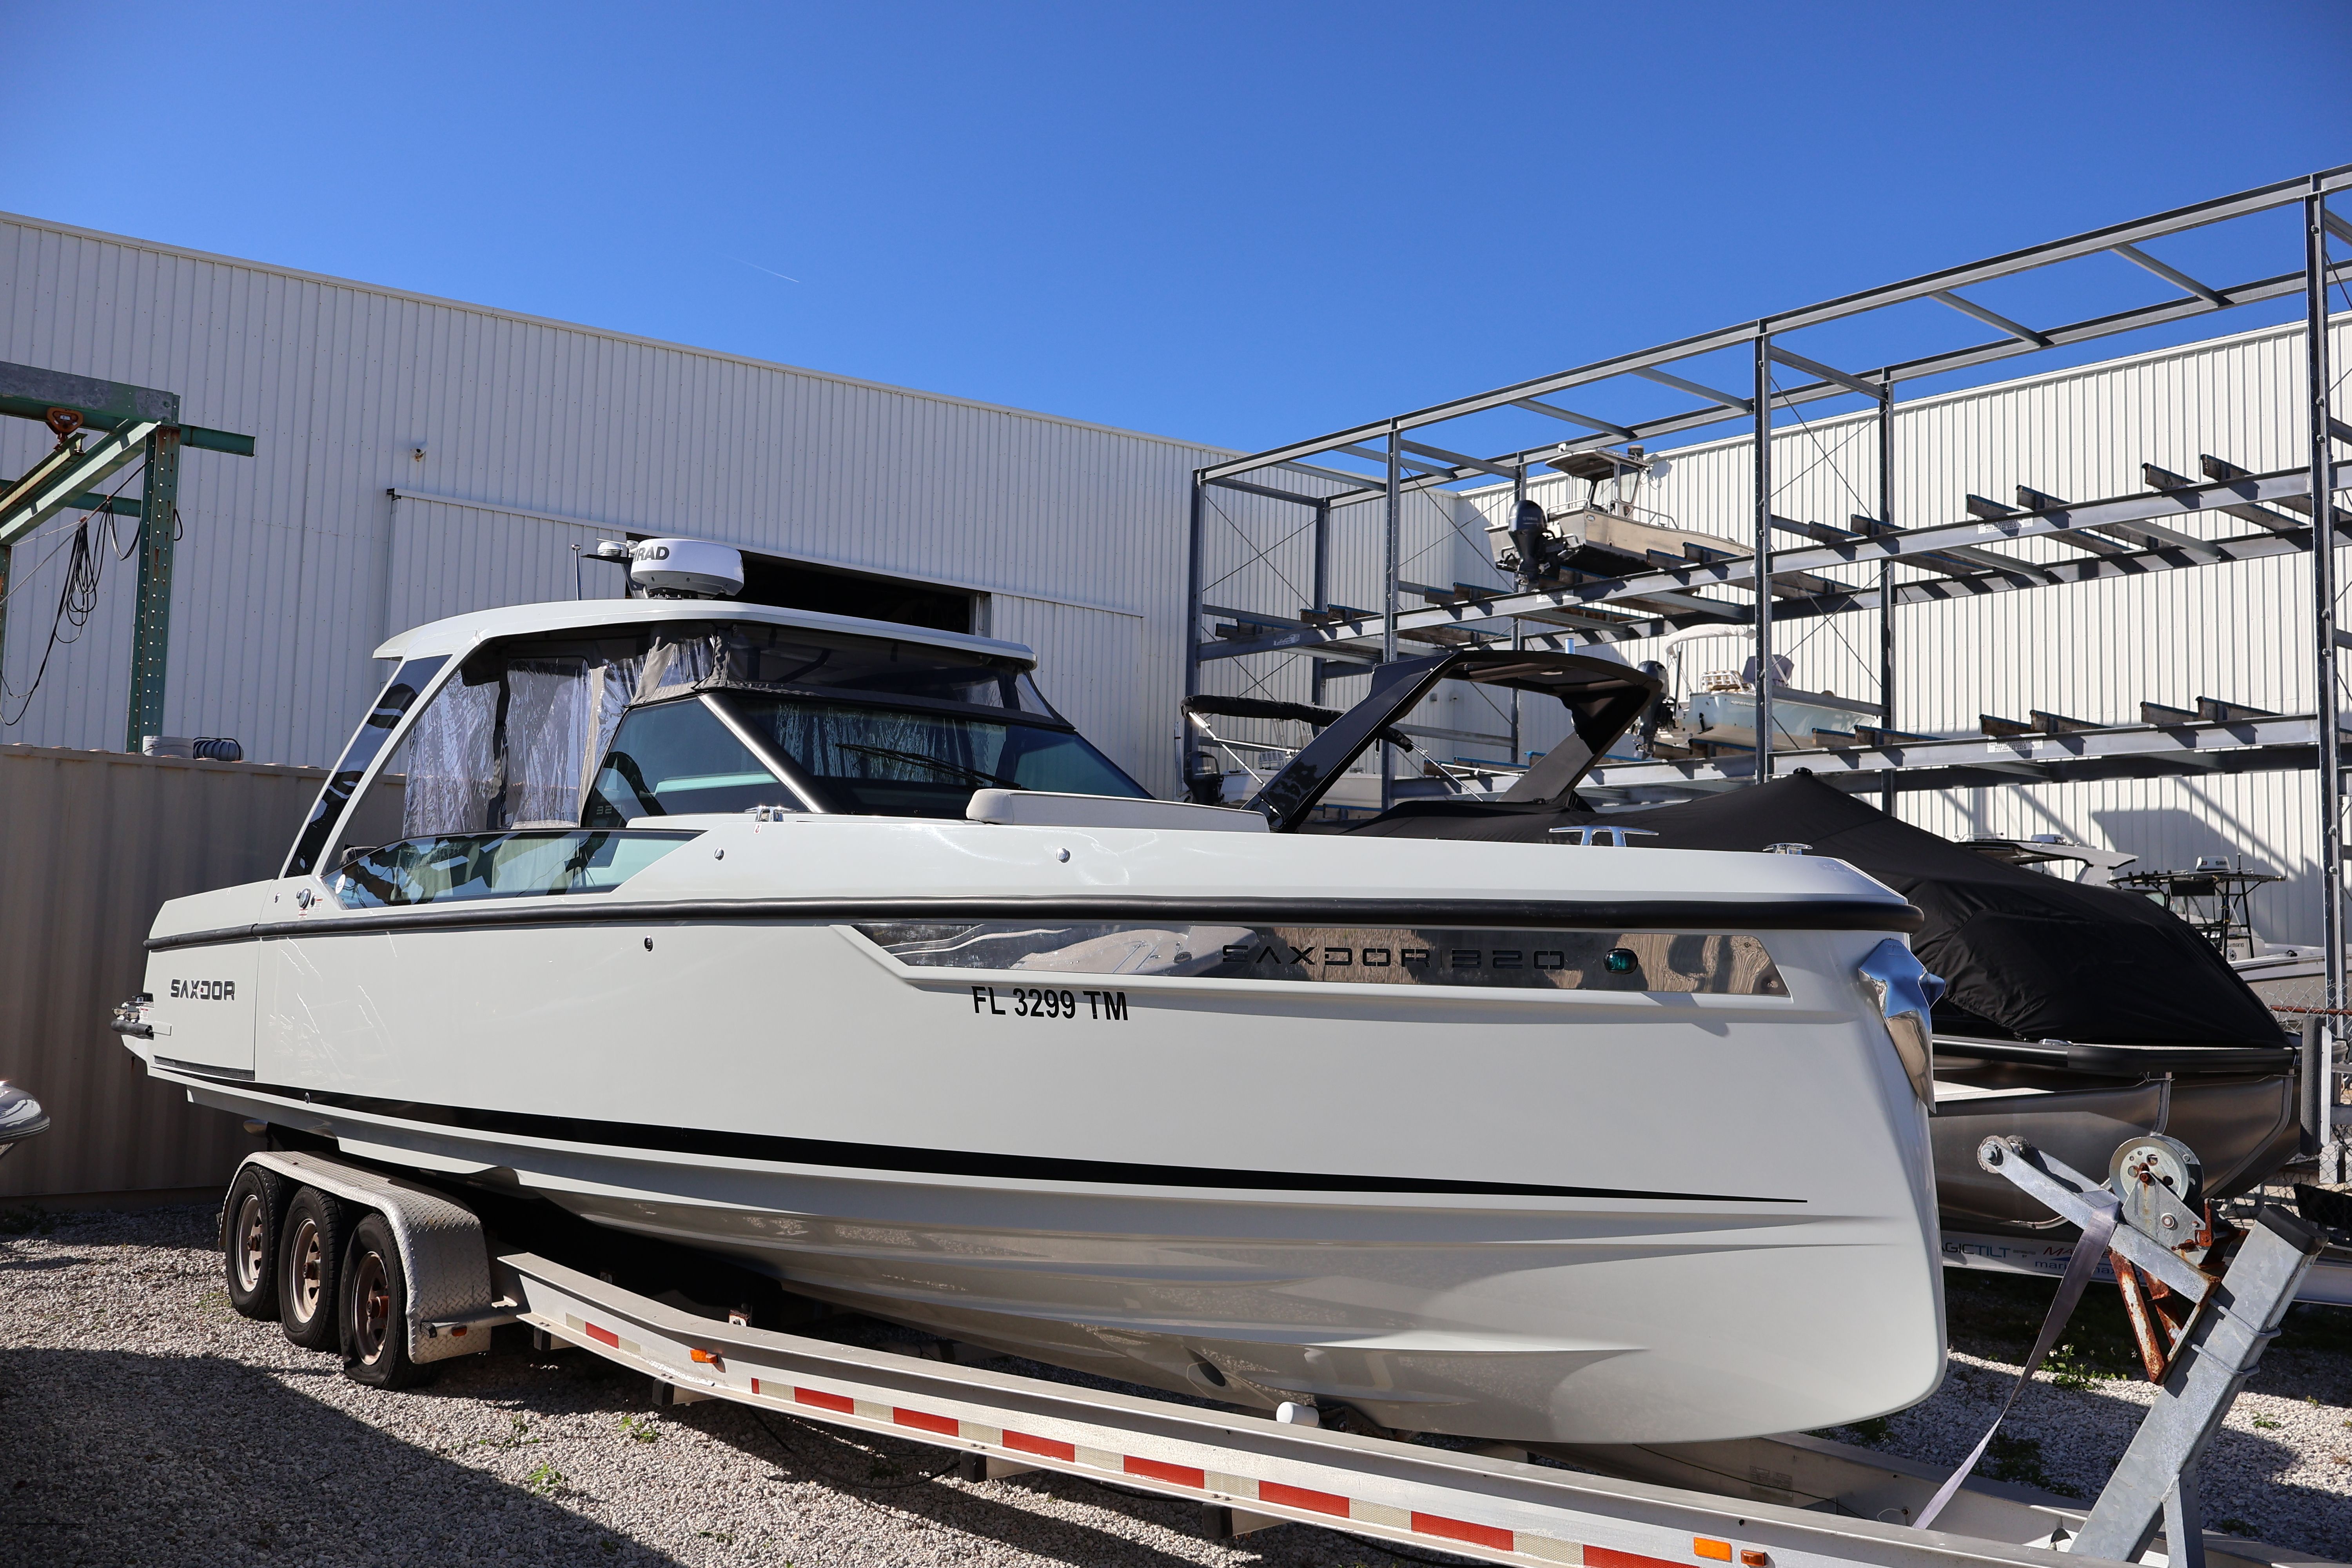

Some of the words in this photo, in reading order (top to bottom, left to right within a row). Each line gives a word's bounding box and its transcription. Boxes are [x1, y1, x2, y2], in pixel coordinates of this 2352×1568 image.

[1223, 945, 1430, 968] SAXDOR
[1452, 949, 1564, 970] 320
[170, 979, 235, 1000] SAXDOR
[971, 986, 1006, 1015] FL
[1013, 988, 1076, 1019] 3299
[1083, 991, 1128, 1020] TM
[1942, 1242, 2011, 1258] GICTILT
